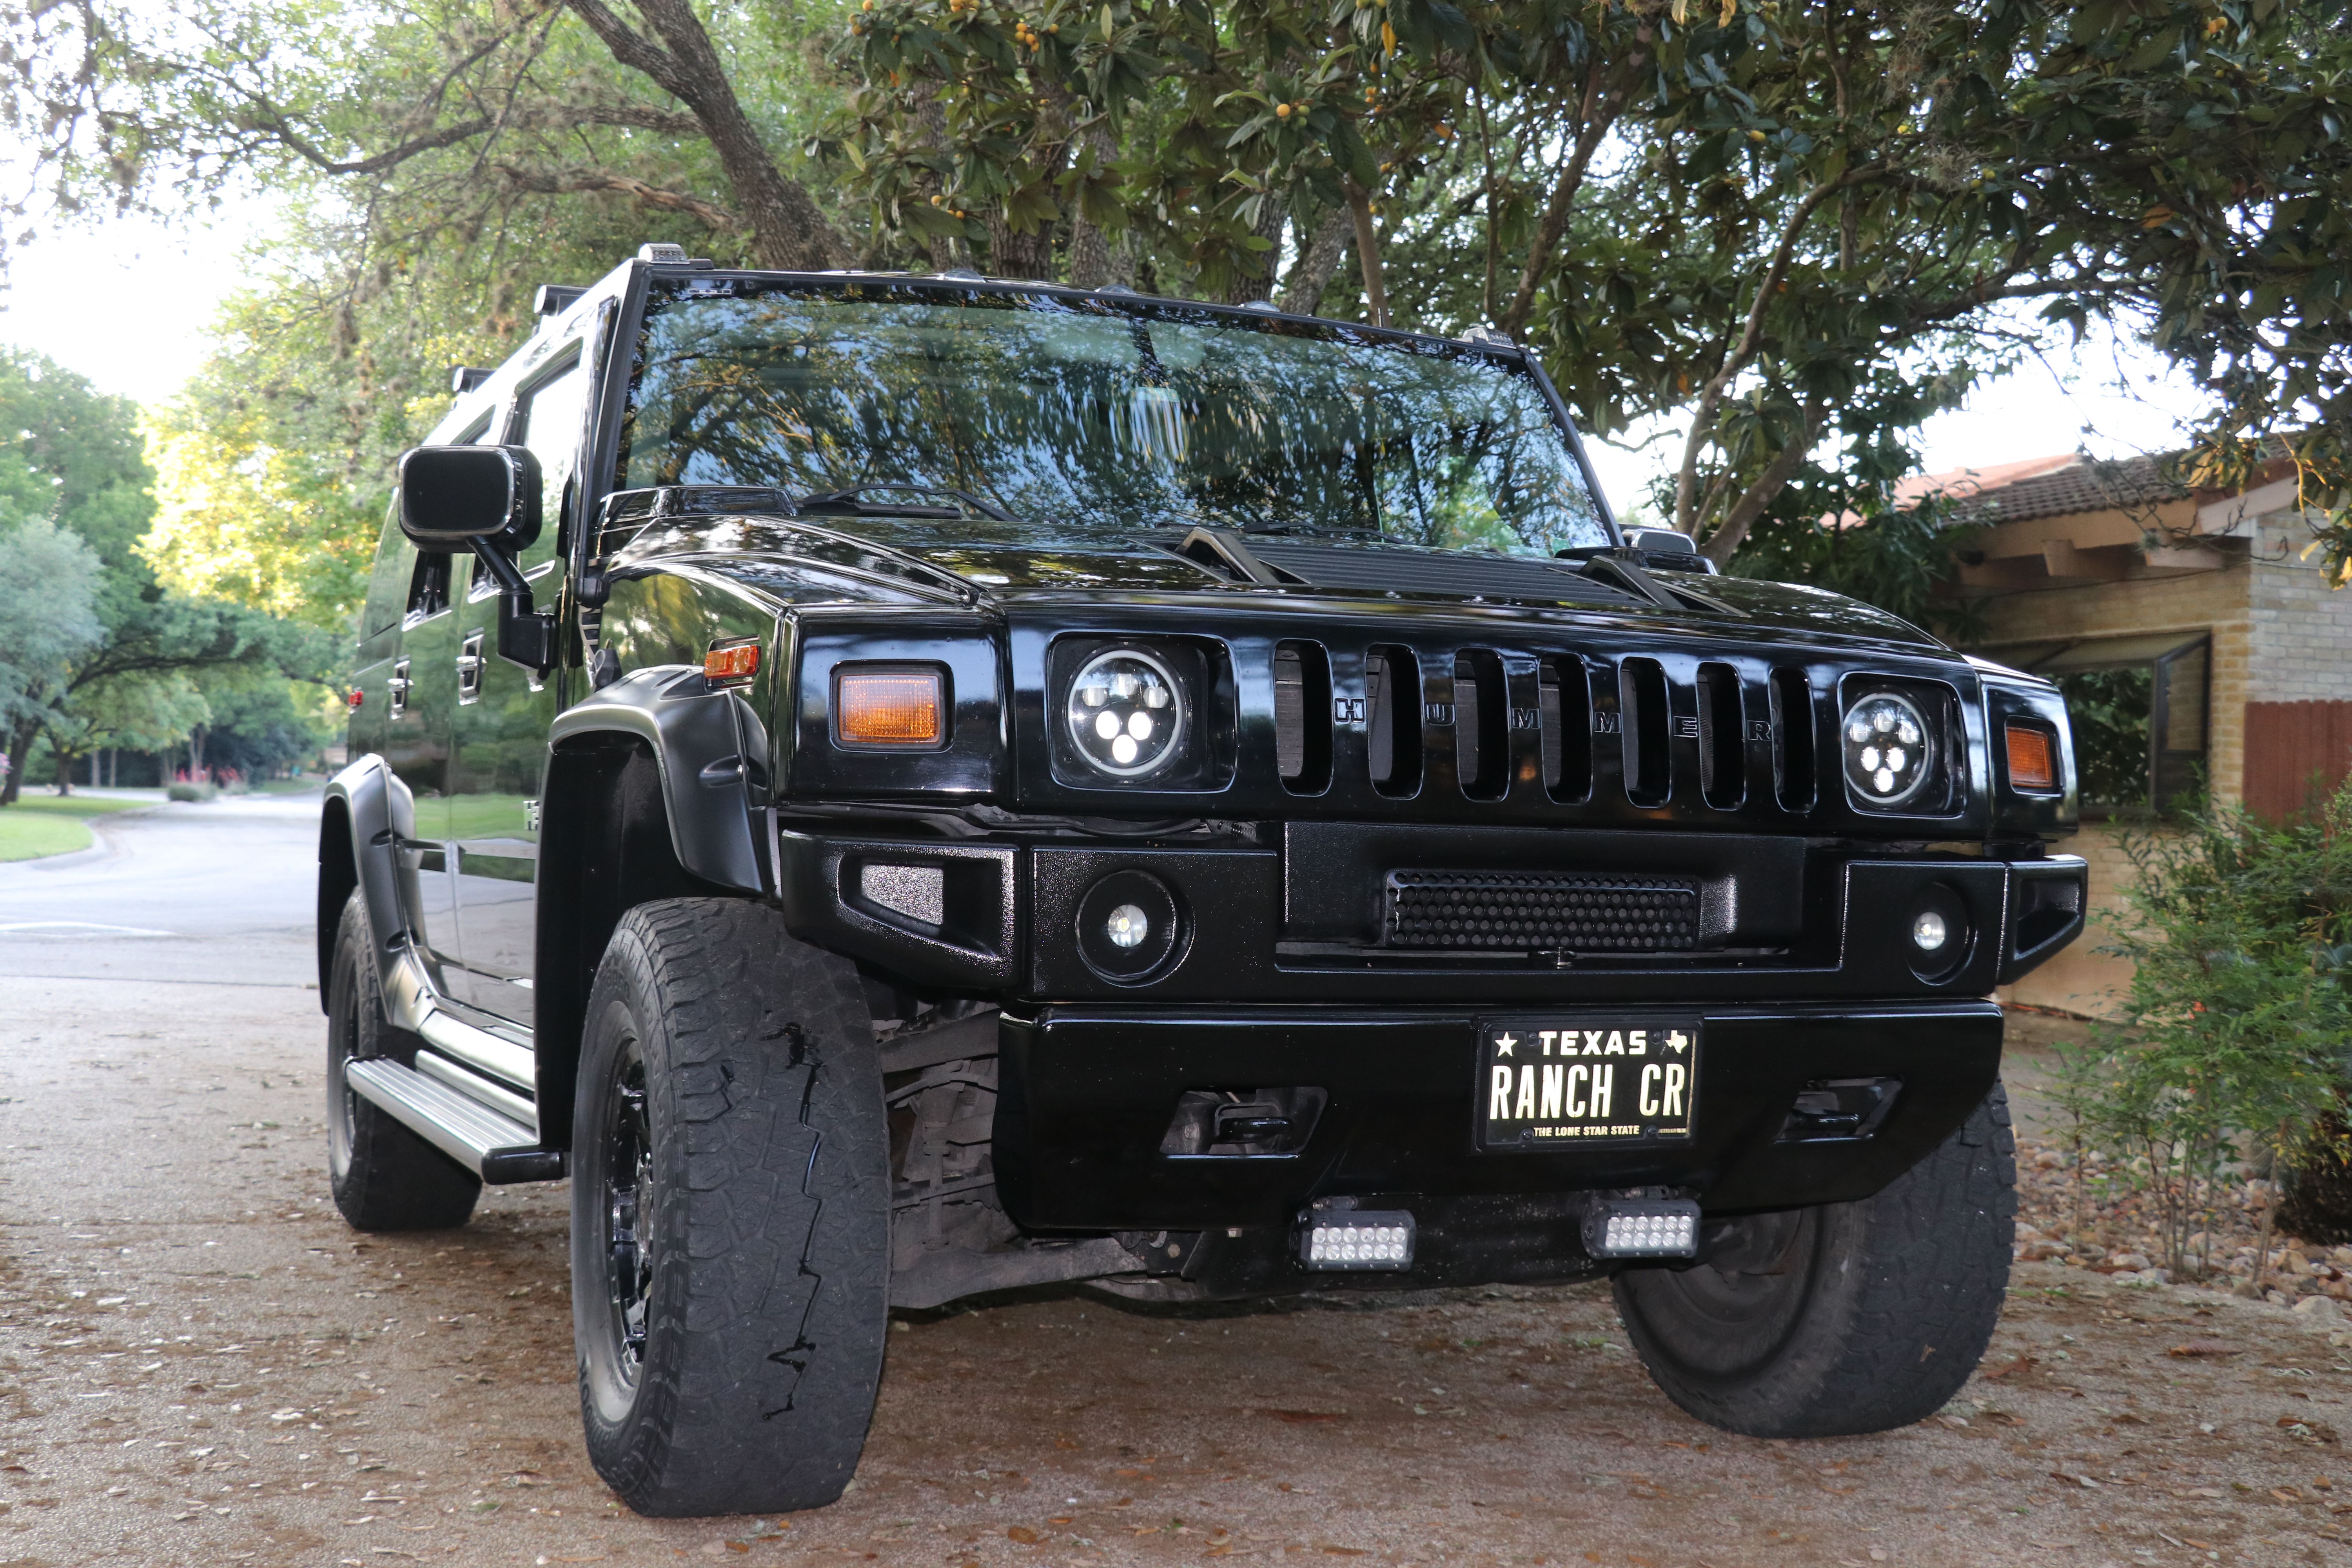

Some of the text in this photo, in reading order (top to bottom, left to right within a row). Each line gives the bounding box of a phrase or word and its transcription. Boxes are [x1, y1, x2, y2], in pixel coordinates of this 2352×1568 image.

[1334, 698, 1772, 742] HUMMER
[1539, 1031, 1646, 1055] TEXAS
[1489, 1063, 1685, 1120] RANCH CR
[1533, 1125, 1640, 1137] THE LONE STAR STATE
